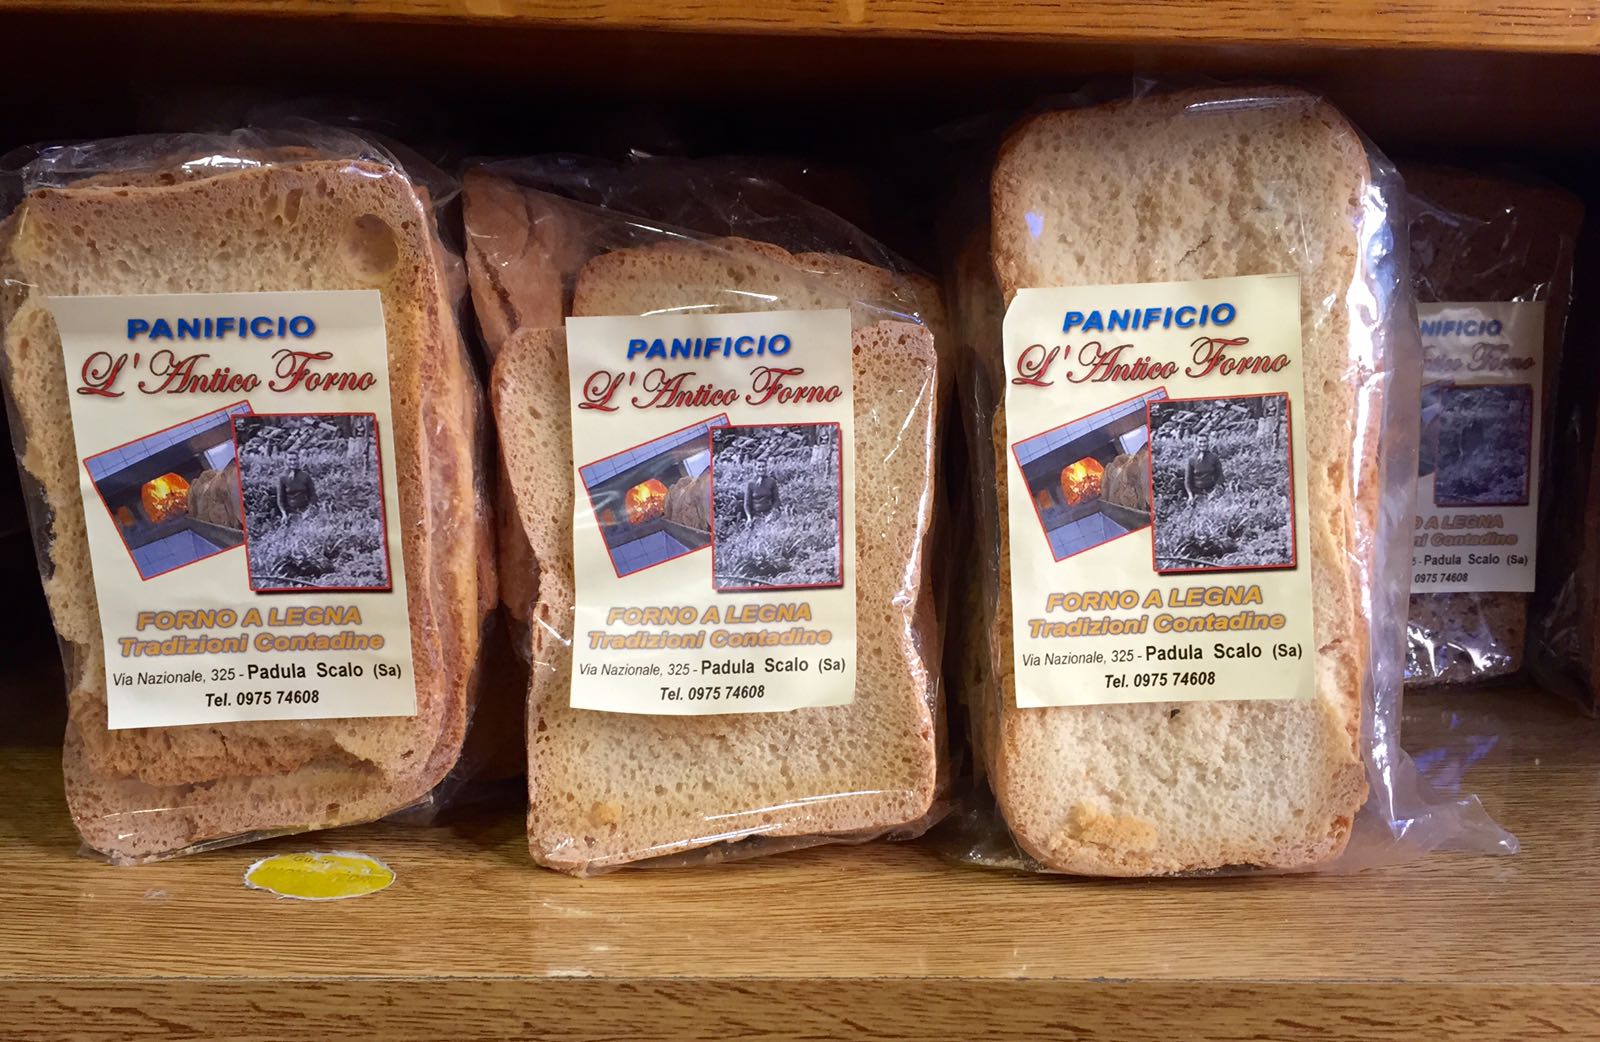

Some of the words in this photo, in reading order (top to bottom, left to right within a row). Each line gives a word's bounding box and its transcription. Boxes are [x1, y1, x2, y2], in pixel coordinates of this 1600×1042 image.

[127, 316, 316, 340] PANIFICIO
[1062, 302, 1237, 334] PANIFICIO
[1420, 319, 1503, 336] NIFICIO
[627, 334, 792, 360] PANIFICIO
[1185, 336, 1291, 378] Forno
[1467, 343, 1536, 371] Forno
[268, 349, 377, 392] Forno
[745, 366, 843, 406] Forno
[1424, 516, 1439, 529] A
[1440, 514, 1504, 530] LEGNA
[1431, 531, 1518, 547] Contadine
[1424, 554, 1461, 566] Padula
[1468, 553, 1500, 565] Scalo
[1507, 554, 1528, 566] (Sa)
[1414, 573, 1437, 583] 0975
[1440, 573, 1468, 582] 74608
[1046, 590, 1139, 613] FORNO
[1142, 589, 1163, 609] A
[1168, 585, 1263, 608] LEGNA
[136, 609, 238, 631] FORNO
[241, 608, 263, 627] A
[267, 606, 362, 627] LEGNA
[606, 606, 698, 626] FORNO
[701, 605, 720, 624] A
[724, 602, 813, 624] LEGNA
[1028, 615, 1149, 639] Tradizioni
[1153, 611, 1286, 634] Contadine
[118, 634, 249, 658] Tradizioni
[254, 631, 385, 652] Contadine
[588, 630, 706, 650] Tradizioni
[709, 628, 833, 648] Contadine
[1022, 653, 1041, 666] Via
[1044, 651, 1106, 666] Nazionale,
[1146, 645, 1203, 661] Padula
[1214, 643, 1262, 659] Scalo
[1273, 644, 1303, 660] (Sa)
[113, 673, 133, 686] Via
[137, 669, 206, 685] Nazionale,
[248, 664, 306, 680] Padula
[316, 662, 364, 677] Scalo
[373, 664, 402, 679] (Sa)
[579, 664, 598, 676] Via
[600, 663, 663, 677] Nazionale,
[701, 659, 755, 675] Padula
[764, 658, 809, 672] Scalo
[818, 659, 846, 673] (Sa)
[1105, 674, 1129, 688] Tel.
[1134, 673, 1168, 687] 0975
[1173, 671, 1216, 686] 74608
[205, 693, 232, 708] Tel.
[236, 691, 272, 706] 0975
[276, 690, 320, 704] 74608
[660, 687, 684, 701] Tel.
[688, 687, 721, 700] 0975
[725, 685, 765, 699] 74608
